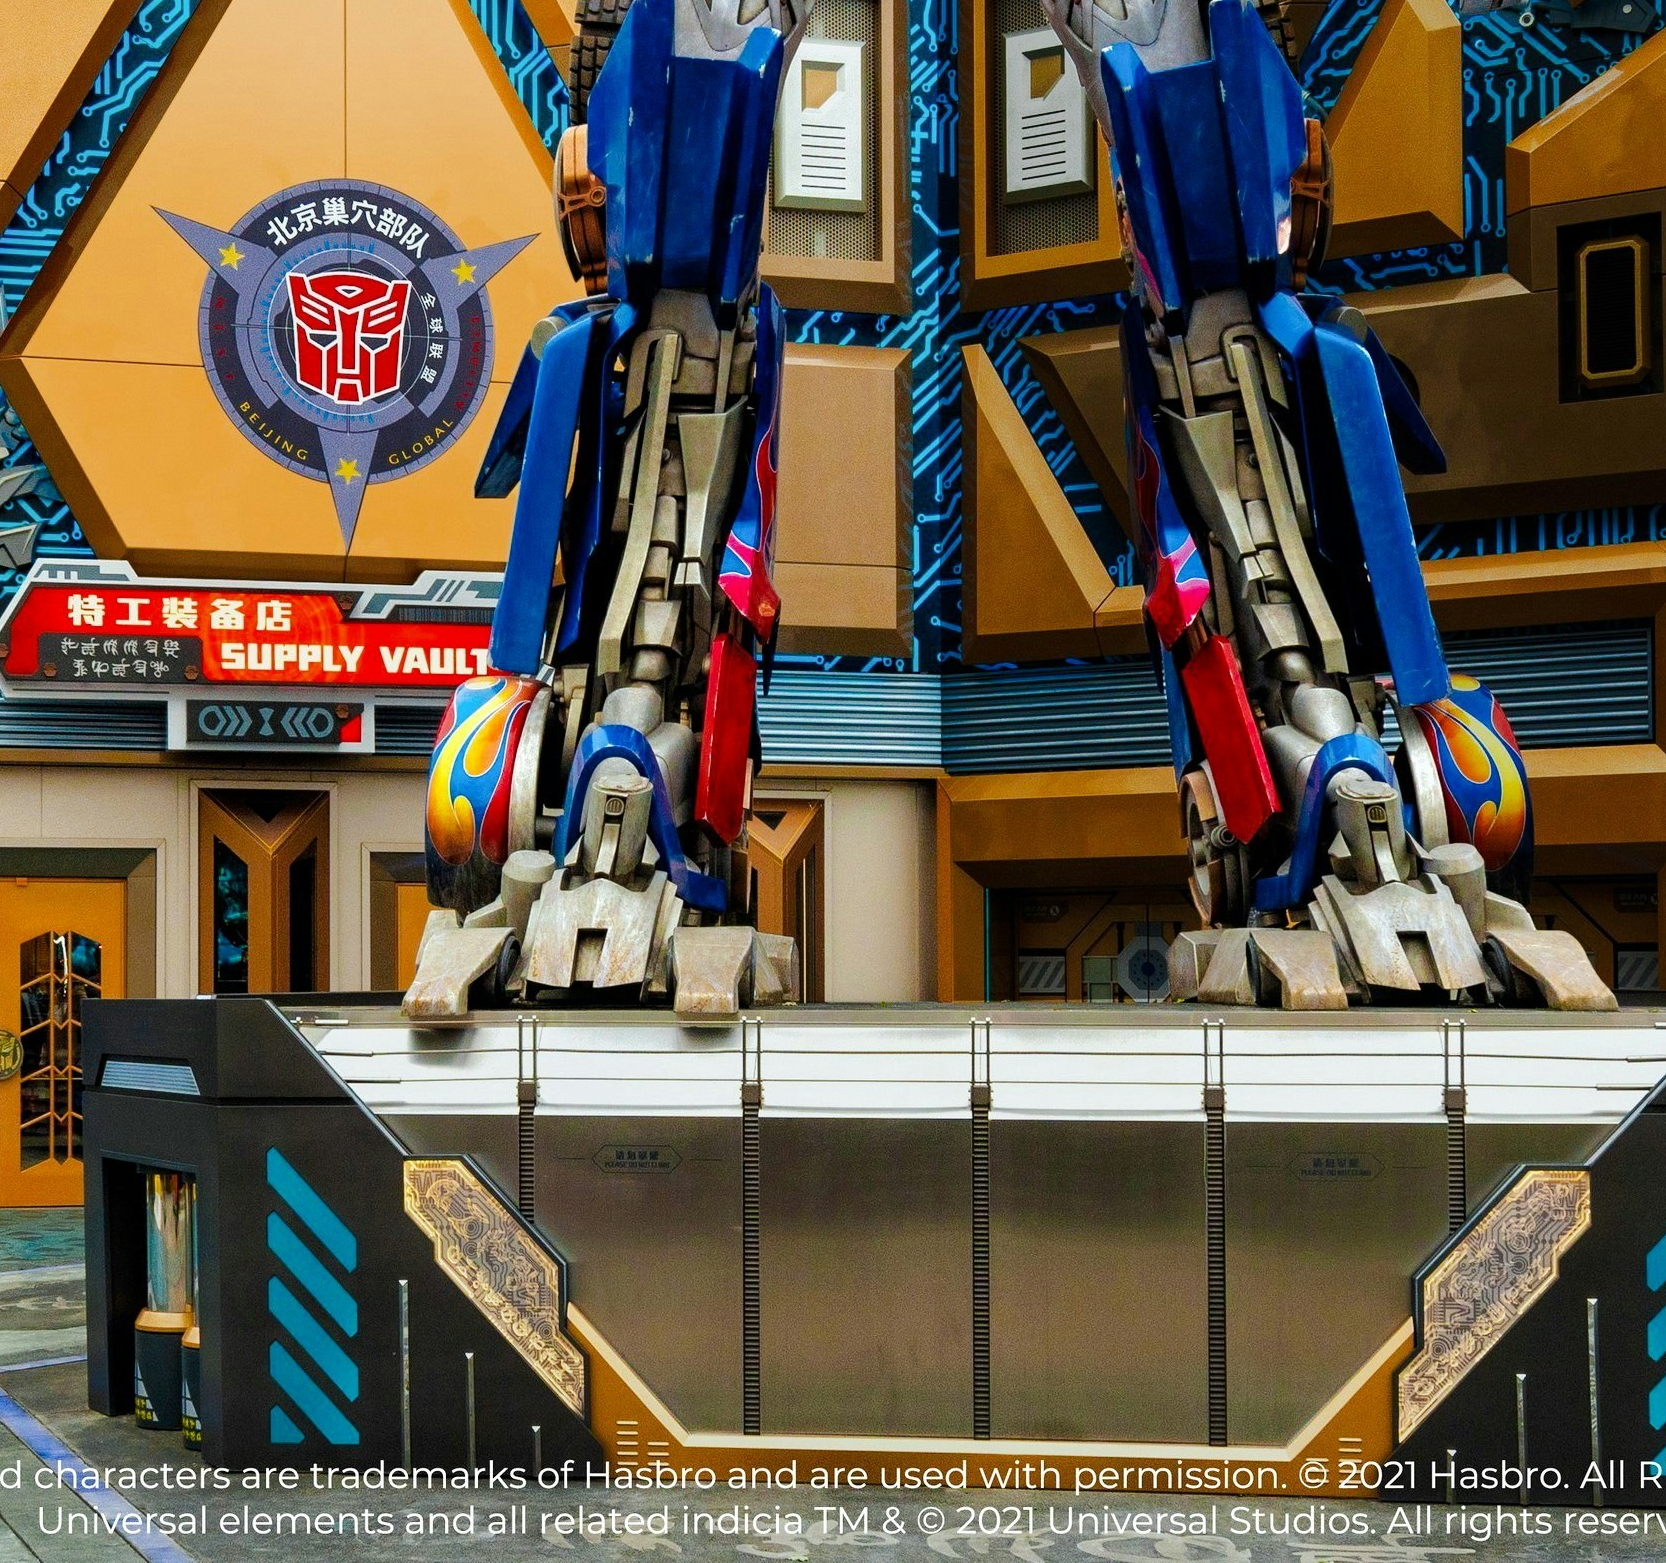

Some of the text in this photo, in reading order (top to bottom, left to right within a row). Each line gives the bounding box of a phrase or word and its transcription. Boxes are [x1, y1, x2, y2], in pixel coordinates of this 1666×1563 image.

[266, 196, 430, 259] 北京巢穴部队
[420, 292, 443, 385] 全球联盟
[239, 401, 308, 461] BEIJING
[388, 418, 454, 466] GLOBAL
[66, 593, 293, 632] 特工装备店
[220, 641, 489, 676] SUPPLY VAULT
